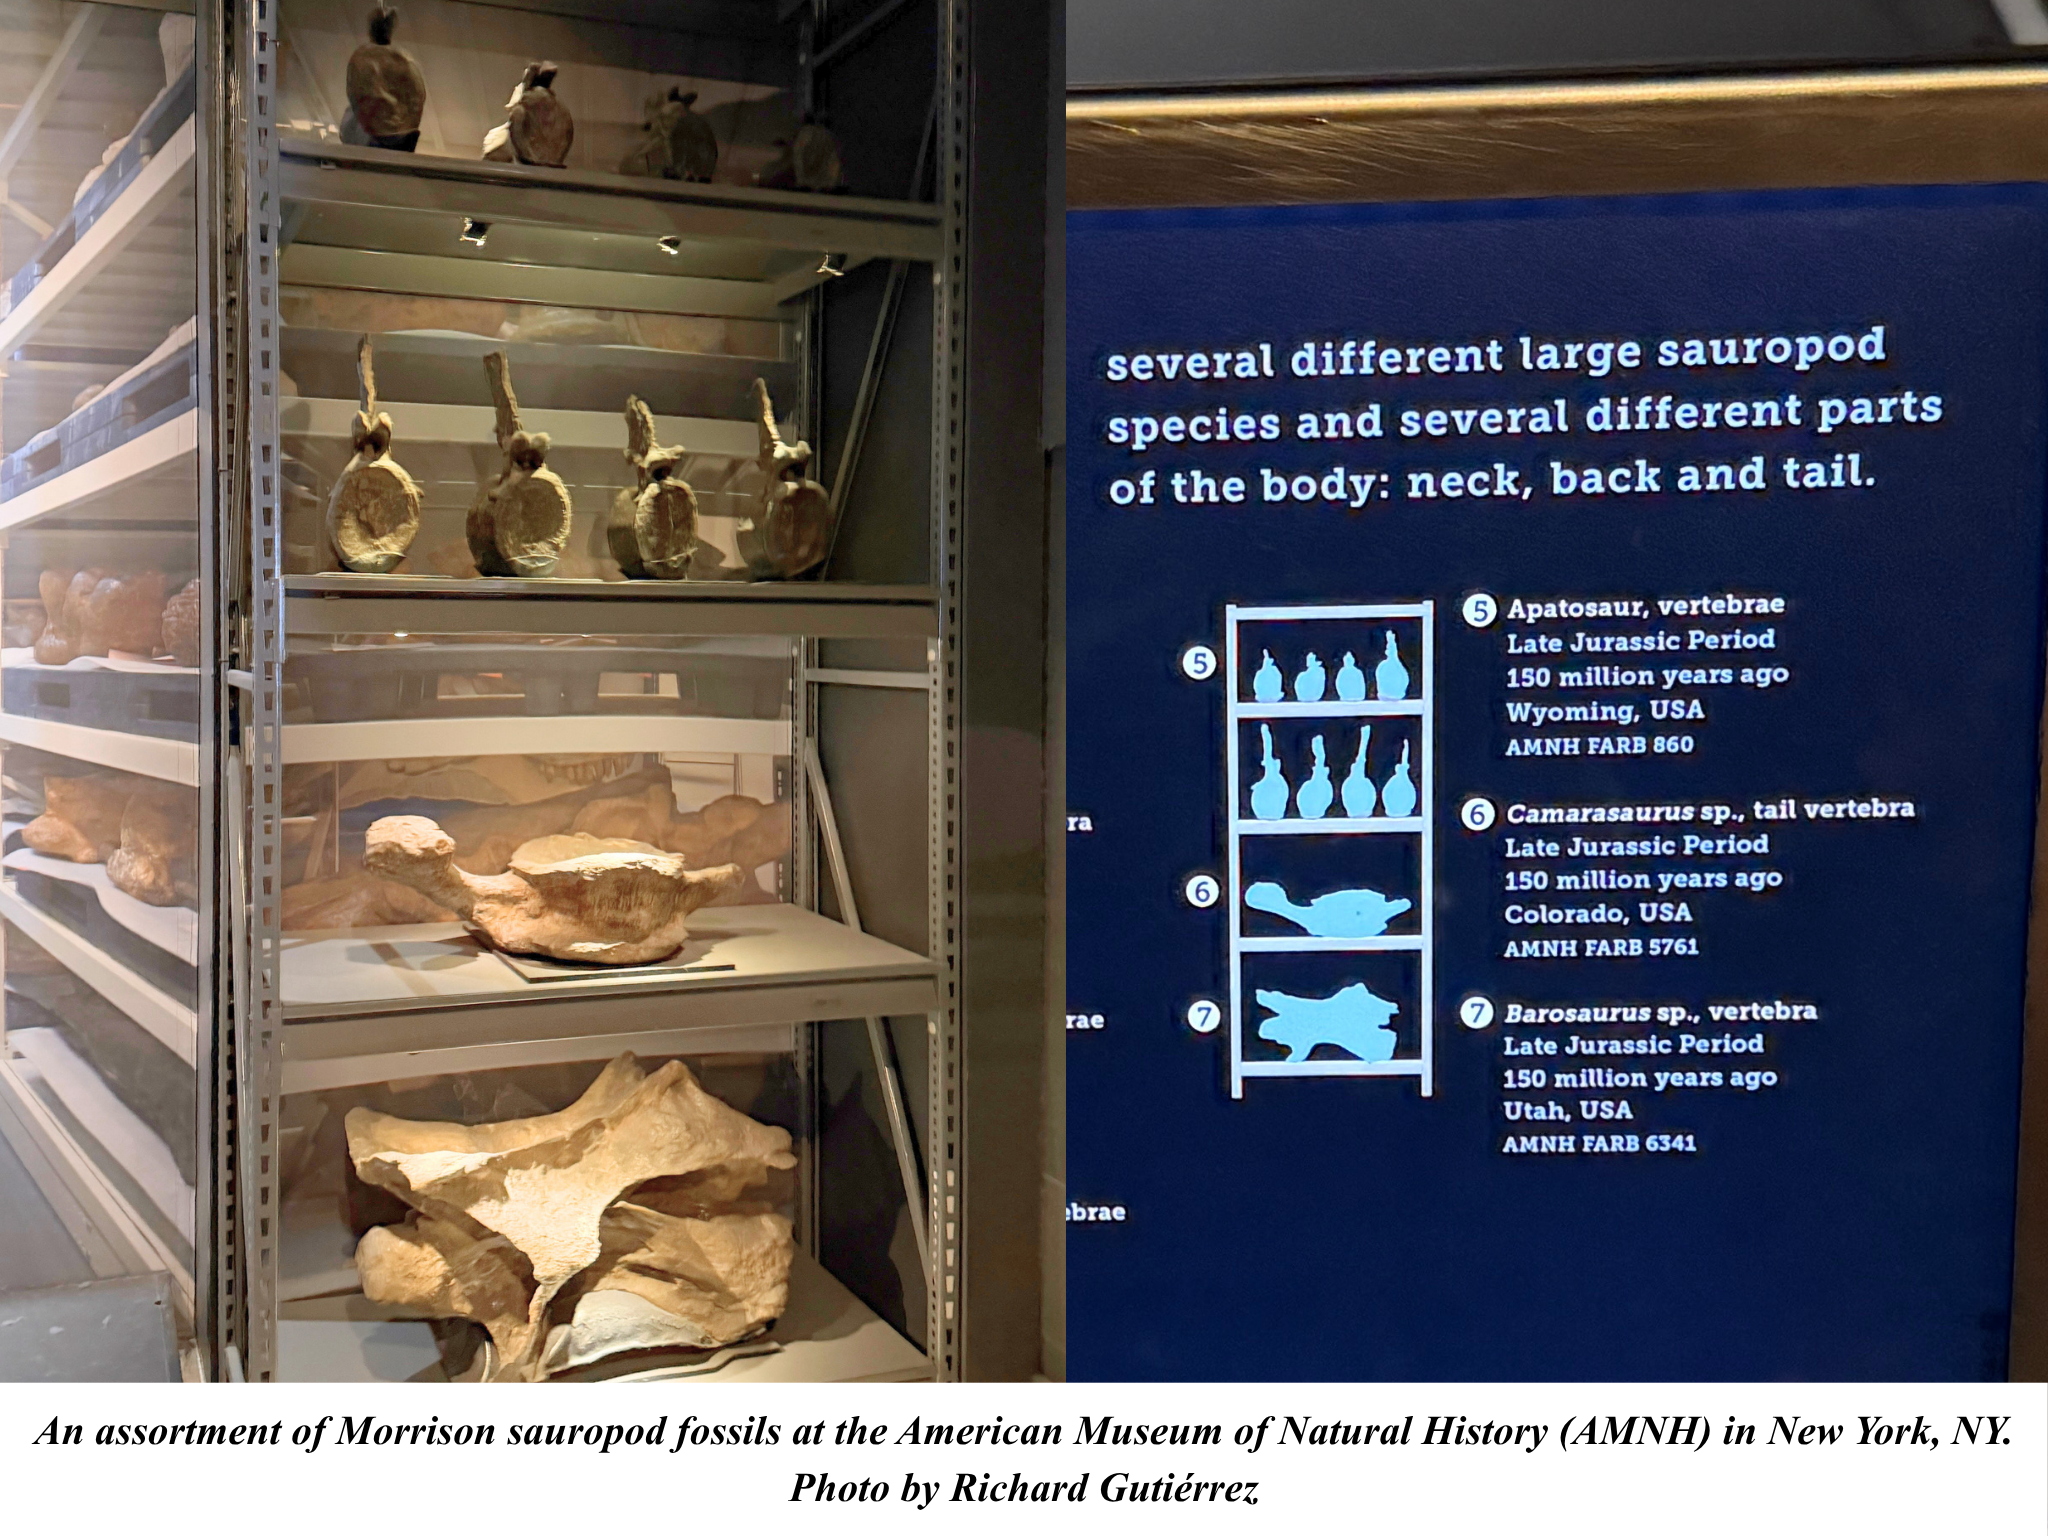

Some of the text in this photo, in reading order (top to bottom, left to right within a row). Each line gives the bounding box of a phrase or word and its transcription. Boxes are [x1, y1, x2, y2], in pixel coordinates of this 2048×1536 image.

[1106, 325, 1886, 381] several different large sauropod
[1108, 390, 1943, 451] species and several different parts
[1109, 453, 1875, 508] of the body: neck, back and tail.
[1506, 598, 1650, 624] Apatosaur,
[1657, 593, 1786, 616] vertebrae
[1507, 627, 1776, 654] Late Jurassic Period
[1506, 665, 1790, 690] 150 million years ago
[1505, 698, 1706, 727] Wyoming, USA
[1505, 735, 1694, 757] AMNH FARB 860
[1507, 803, 1695, 824] Camarasaurus
[1700, 805, 1745, 826] sp.,
[1753, 798, 1797, 820] tail
[1803, 797, 1916, 819] vertebra
[1505, 833, 1770, 858] Late Jurassic Period
[1505, 869, 1783, 894] 150 million years ago
[1504, 902, 1694, 926] Colorado, USA
[1503, 937, 1700, 958] AMNH FARB 5761
[1504, 1003, 1652, 1024] Barosaurus
[1656, 1006, 1701, 1027] sp.,
[1707, 1000, 1819, 1021] vertebra
[1503, 1032, 1765, 1056] Late Jurassic Period
[1503, 1067, 1778, 1092] 150 million years ago
[1503, 1099, 1634, 1123] Utah, USA
[1502, 1134, 1697, 1153] AMNH FARB 6341
